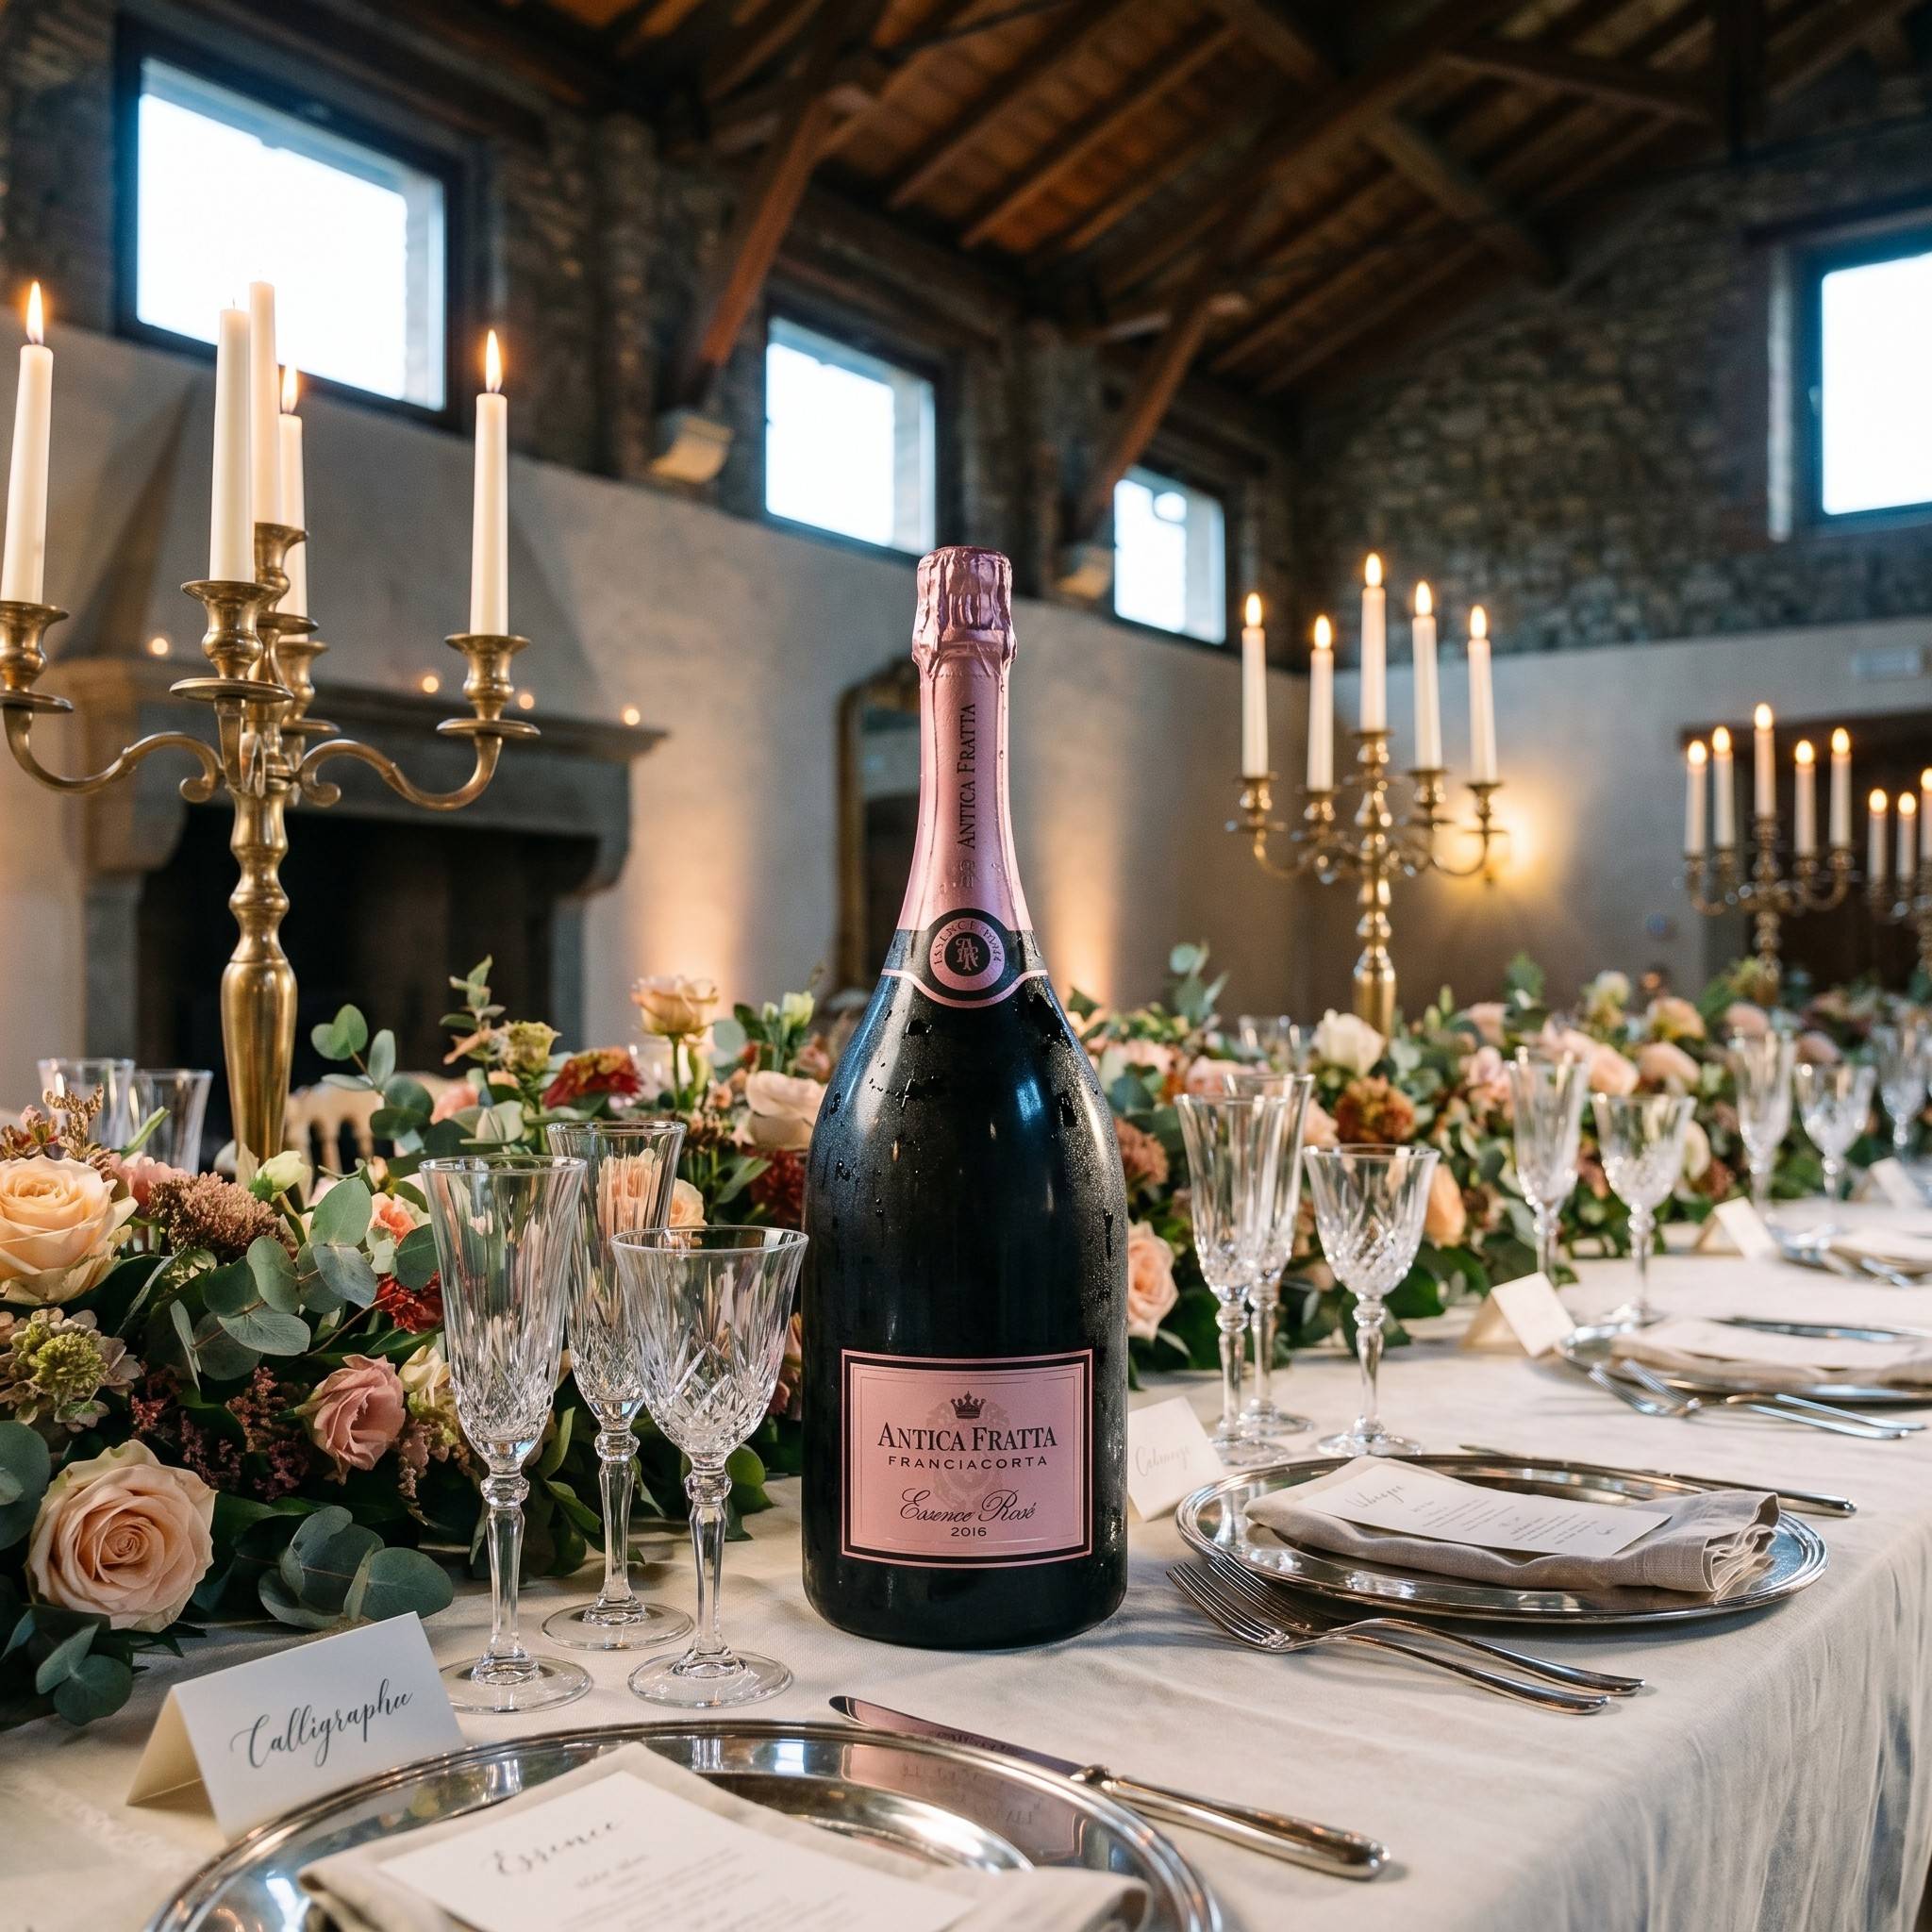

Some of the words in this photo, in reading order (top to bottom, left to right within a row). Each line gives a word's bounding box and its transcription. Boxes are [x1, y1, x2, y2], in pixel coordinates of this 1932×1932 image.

[958, 704, 975, 774] FRATTA
[958, 780, 975, 849] ANTICA
[877, 1422, 967, 1451] ANTICA
[972, 1425, 1058, 1451] FRATTA
[888, 1456, 1048, 1470] FRANCIACORTA
[900, 1488, 975, 1523] Essence
[977, 1489, 1036, 1523] Rosé
[950, 1526, 988, 1537] 2016
